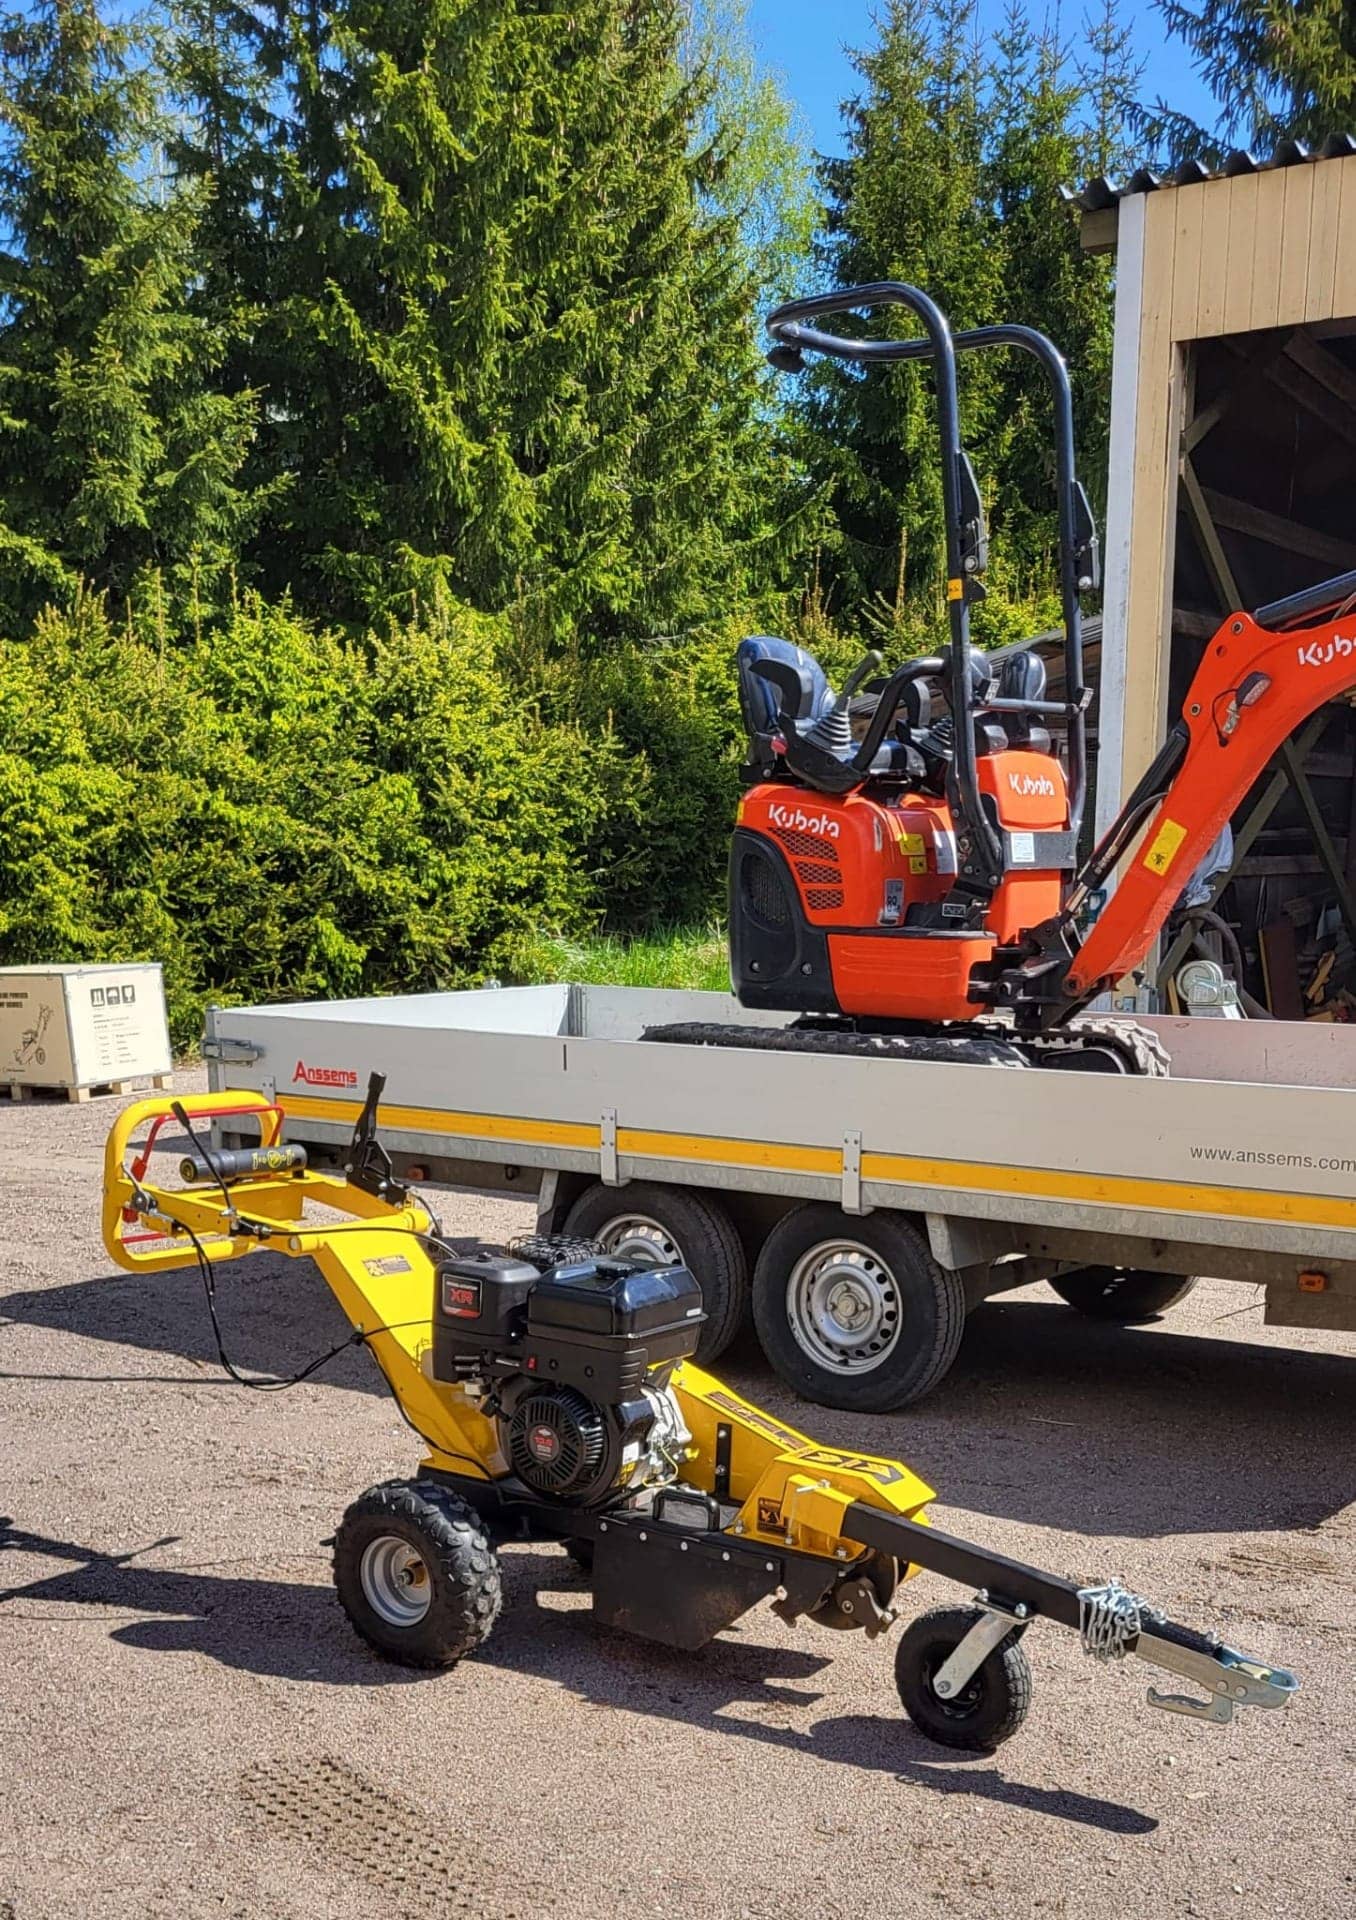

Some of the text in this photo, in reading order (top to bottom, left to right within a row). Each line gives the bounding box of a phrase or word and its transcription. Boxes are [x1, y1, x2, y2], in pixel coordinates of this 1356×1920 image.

[768, 803, 839, 838] Kubota
[293, 1061, 357, 1087] Anssems
[1190, 1147, 1356, 1172] www.anssems.com
